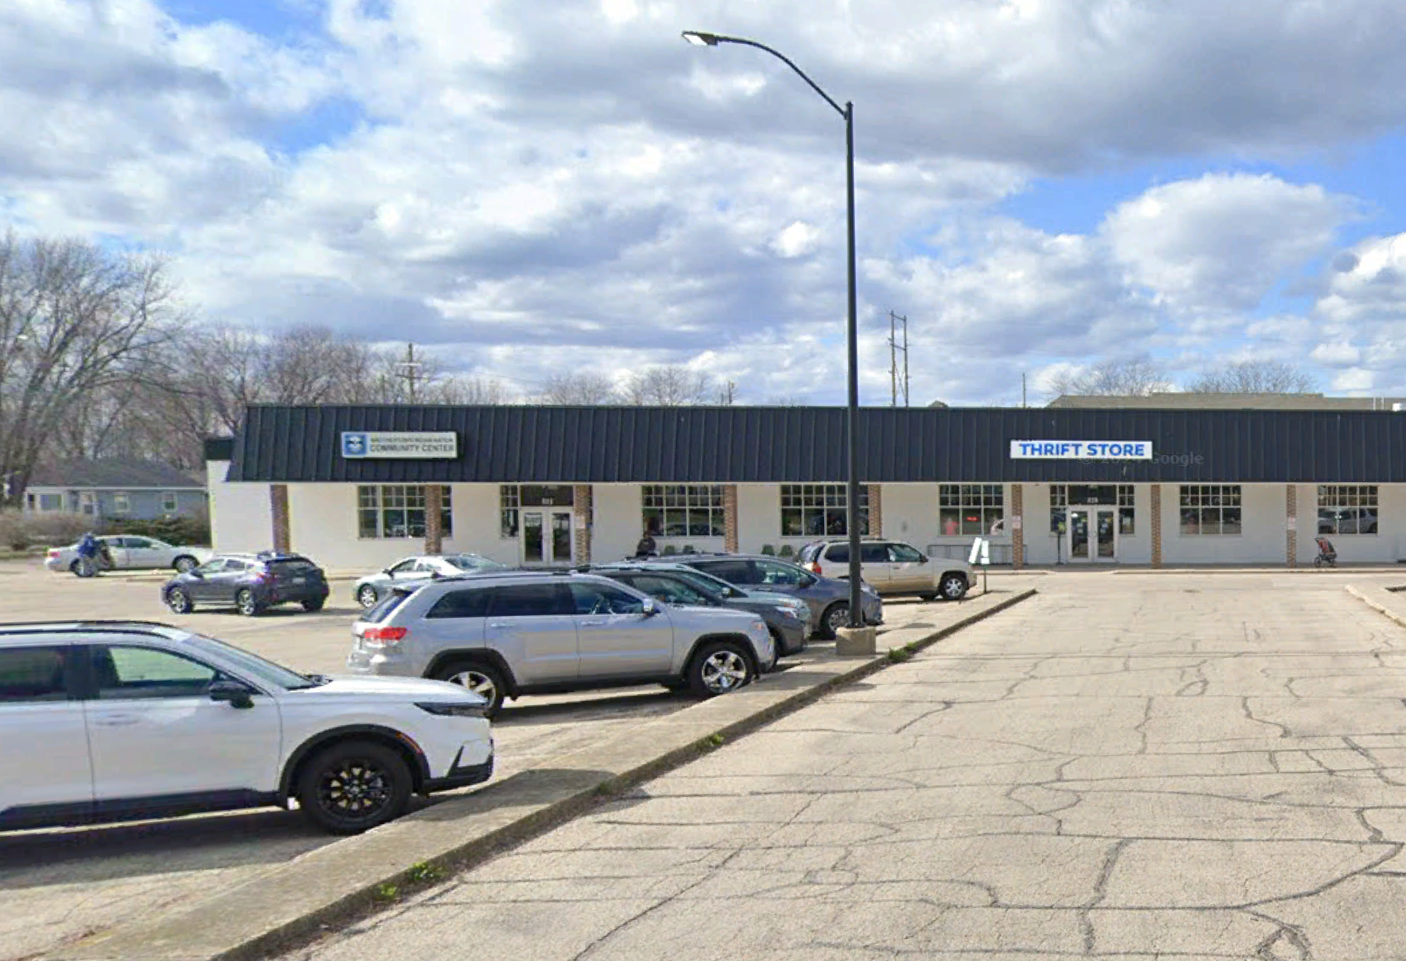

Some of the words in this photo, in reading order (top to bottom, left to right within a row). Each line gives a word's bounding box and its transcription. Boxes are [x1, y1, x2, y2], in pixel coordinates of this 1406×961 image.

[421, 444, 454, 452] CENTER
[1018, 443, 1082, 456] THRIFT
[1087, 443, 1145, 456] STORE
